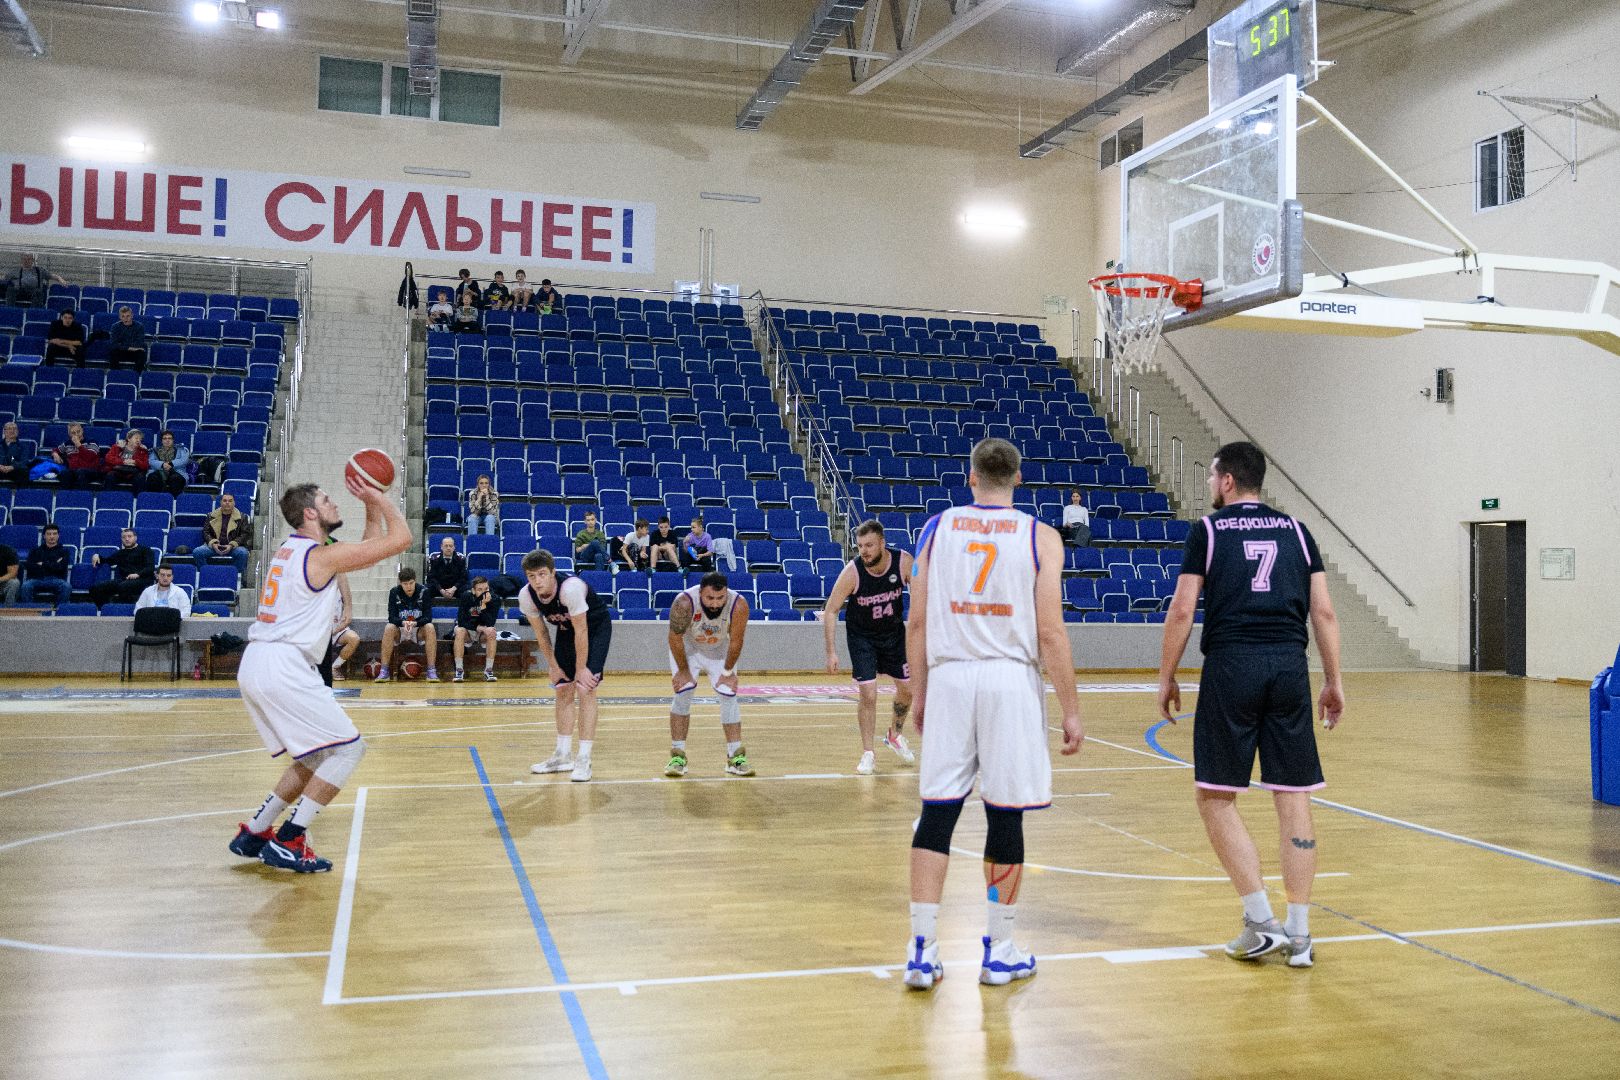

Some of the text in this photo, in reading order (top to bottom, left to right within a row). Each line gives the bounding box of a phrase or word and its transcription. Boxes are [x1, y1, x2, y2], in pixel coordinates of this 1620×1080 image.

[0, 163, 635, 265] ЫШЕ! СИЛЬНЕЕ!
[1215, 517, 1294, 530] ФЕДЮШИН
[964, 540, 999, 595] 7
[1243, 540, 1278, 592] 7
[872, 602, 894, 619] 84
